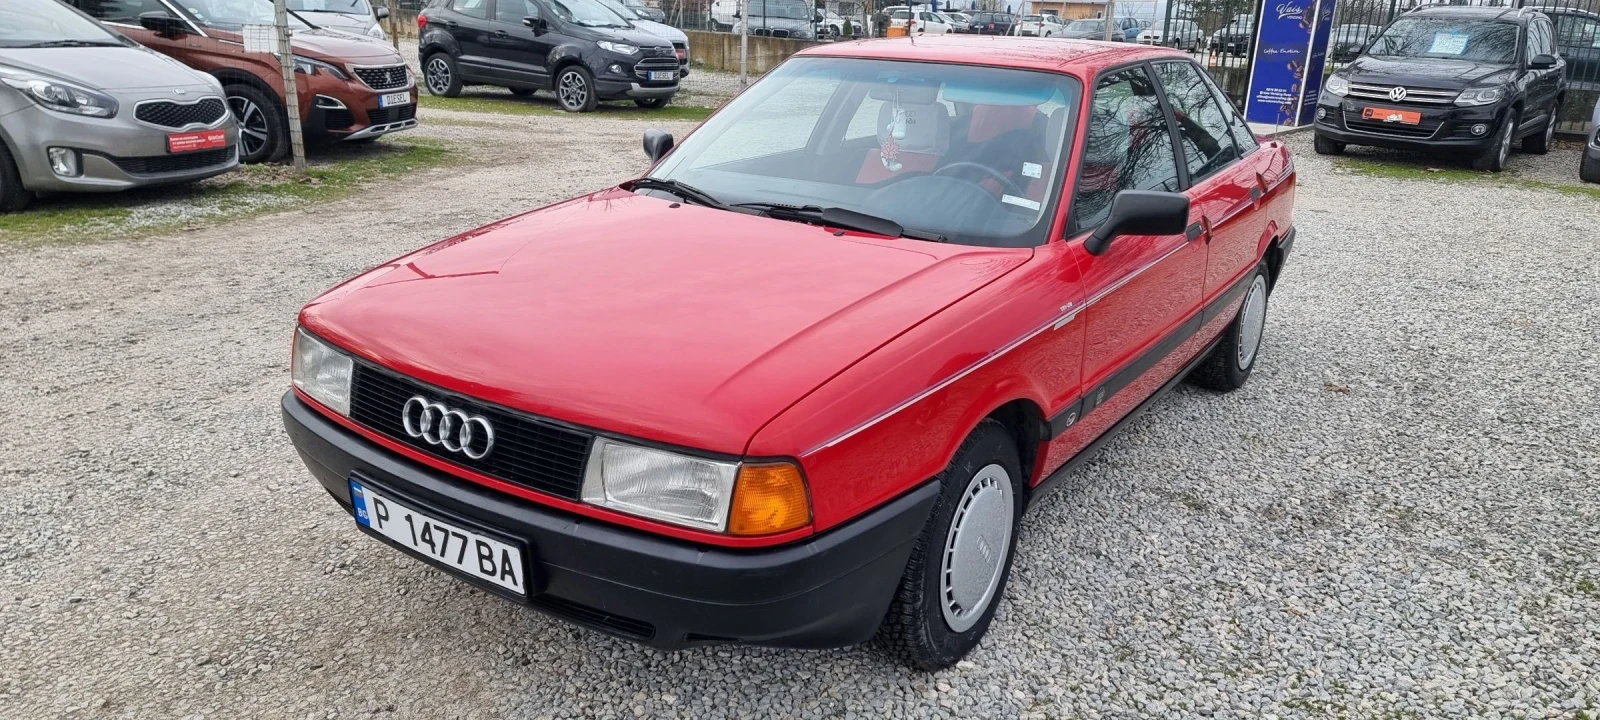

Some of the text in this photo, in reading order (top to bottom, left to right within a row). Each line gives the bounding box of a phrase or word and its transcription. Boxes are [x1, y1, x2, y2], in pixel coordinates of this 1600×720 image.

[1276, 1, 1303, 16] Vais
[386, 93, 407, 105] DIESEL
[357, 508, 368, 519] BG
[372, 497, 519, 587] P 1477 BA
